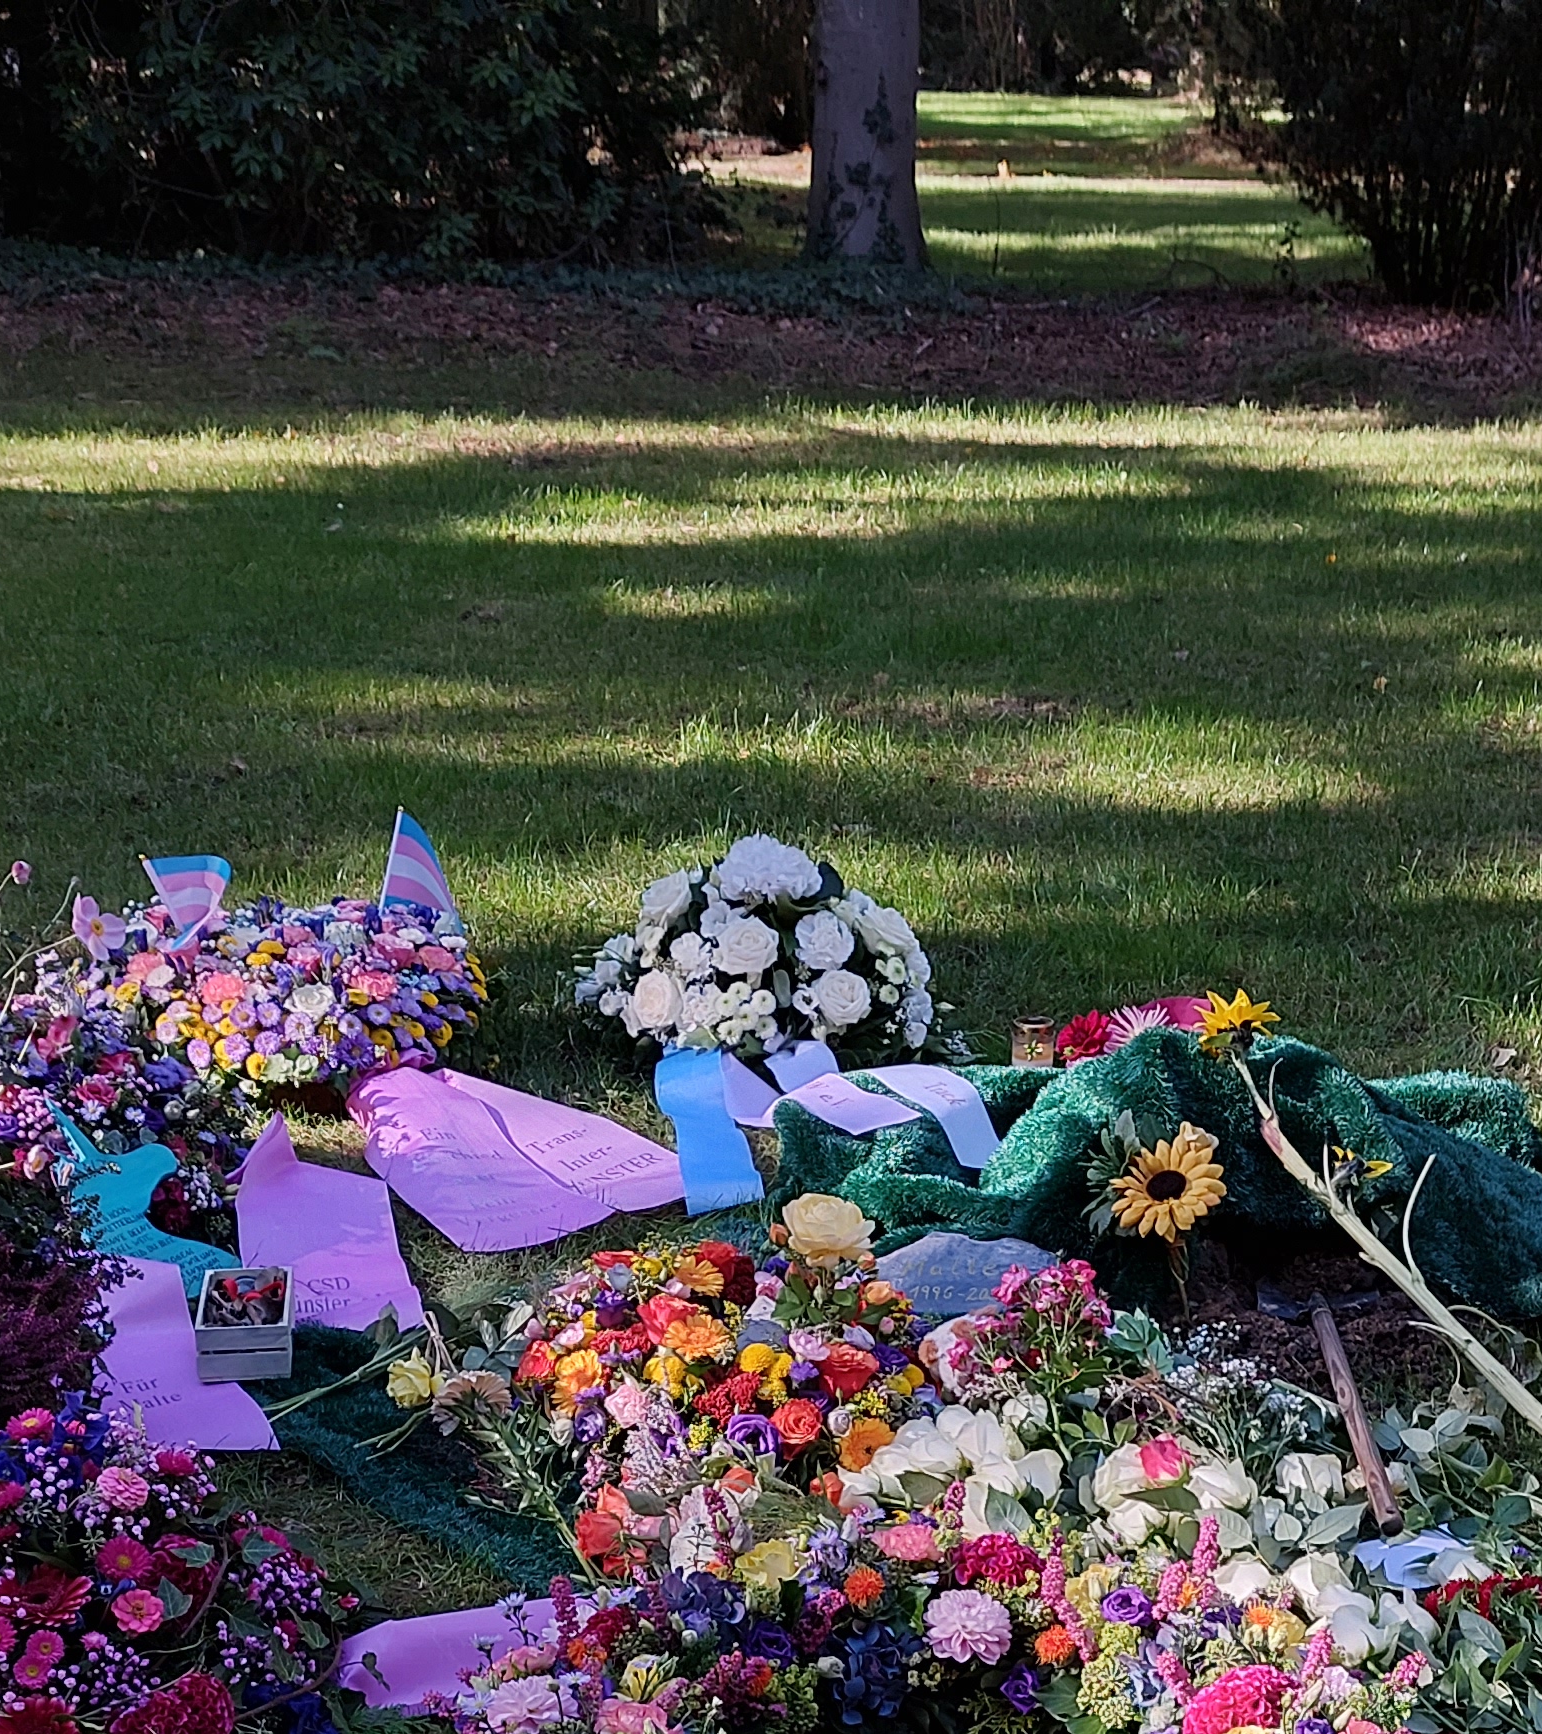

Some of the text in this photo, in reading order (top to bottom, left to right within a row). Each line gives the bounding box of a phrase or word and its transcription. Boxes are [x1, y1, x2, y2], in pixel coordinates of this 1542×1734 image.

[419, 1127, 457, 1142] Ein
[525, 1127, 588, 1156] Trans-
[556, 1146, 612, 1173] Inter-
[307, 1276, 351, 1292] CSD
[119, 1378, 158, 1394] Für
